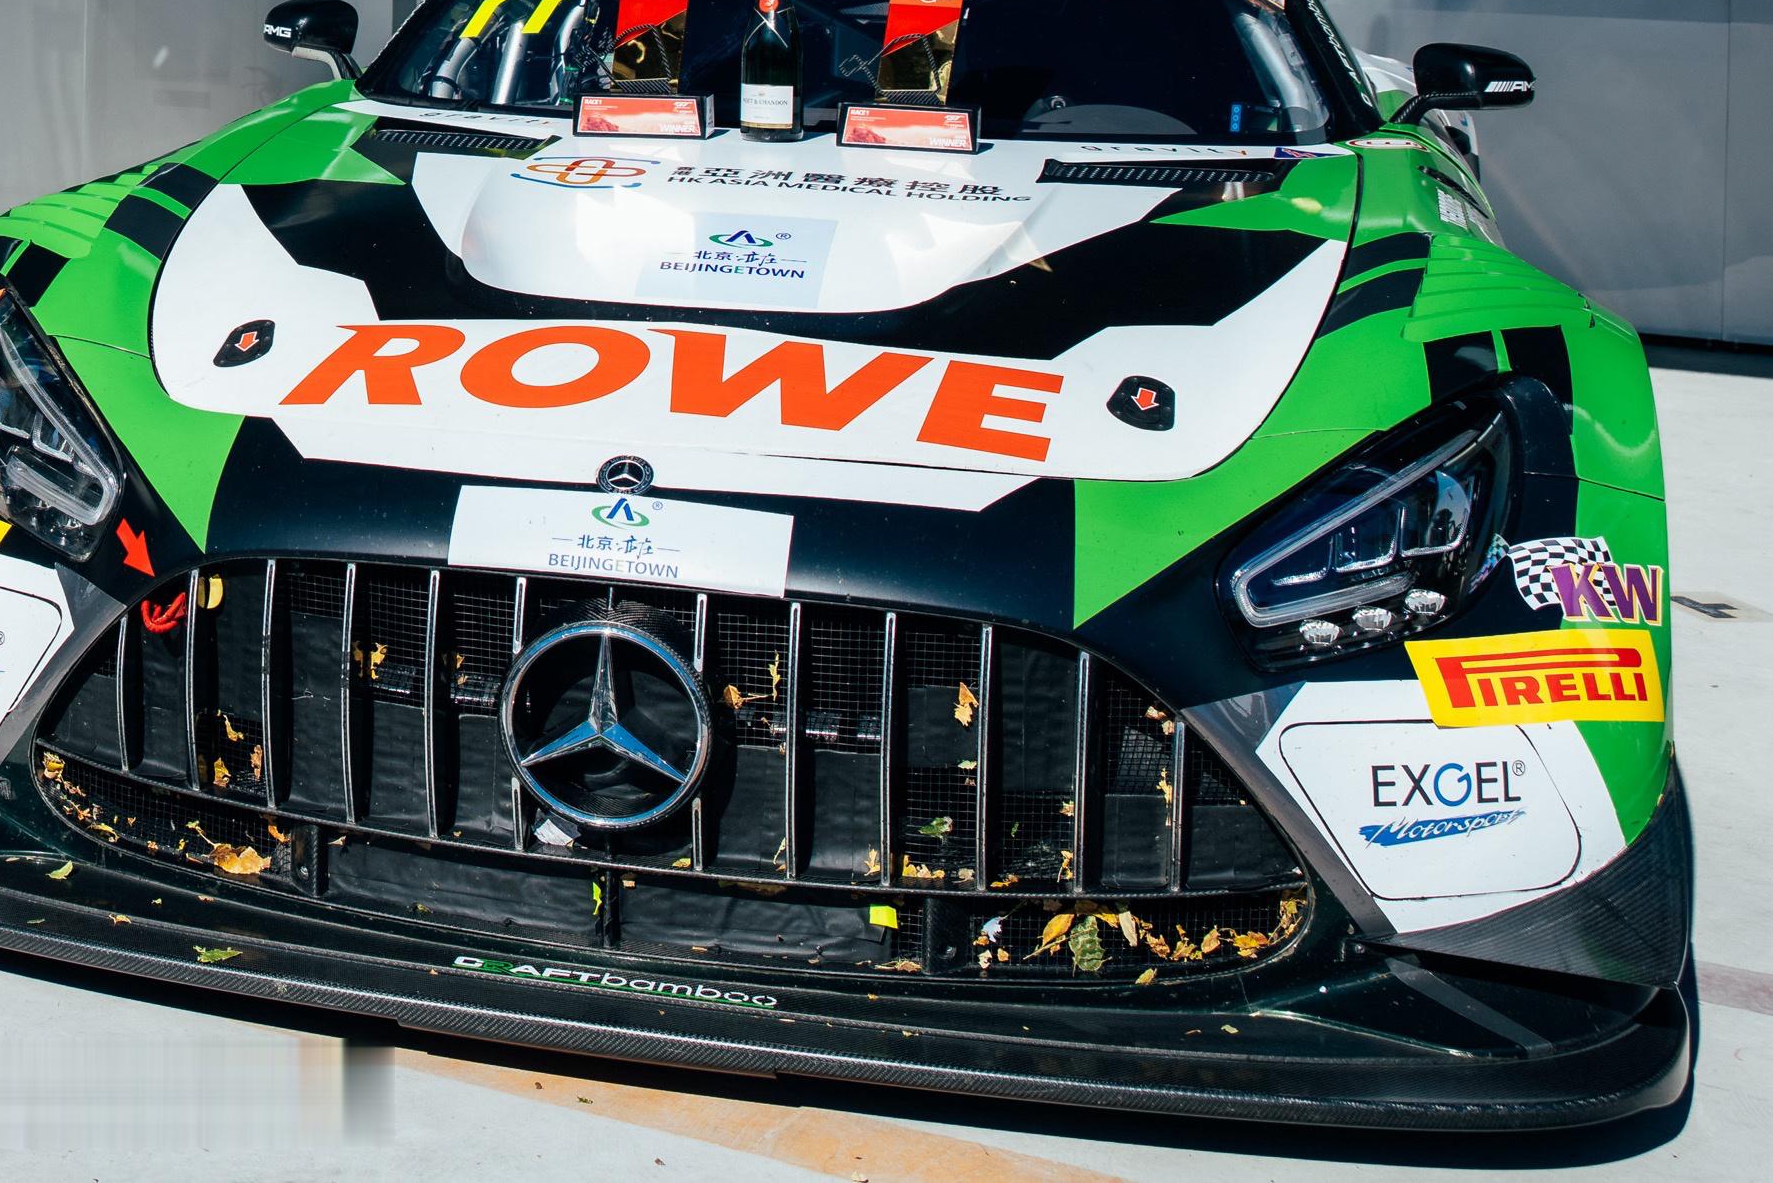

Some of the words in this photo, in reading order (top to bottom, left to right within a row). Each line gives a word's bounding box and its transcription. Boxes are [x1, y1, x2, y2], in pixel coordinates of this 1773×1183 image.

[263, 23, 292, 38] AMG
[659, 123, 696, 133] WINNER
[929, 137, 967, 148] WINNER
[667, 176, 703, 185] HK
[714, 177, 769, 188] ASIA
[776, 181, 898, 198] MEDICAL
[905, 191, 1032, 202] HOLDING
[659, 261, 805, 280] BEIJINGETOWN
[279, 325, 1065, 462] ROWE
[548, 553, 679, 579] BEIJINGETOWN
[1548, 561, 1665, 626] KW
[1434, 647, 1649, 709] PIRELLI
[1361, 808, 1526, 848] Motorsport
